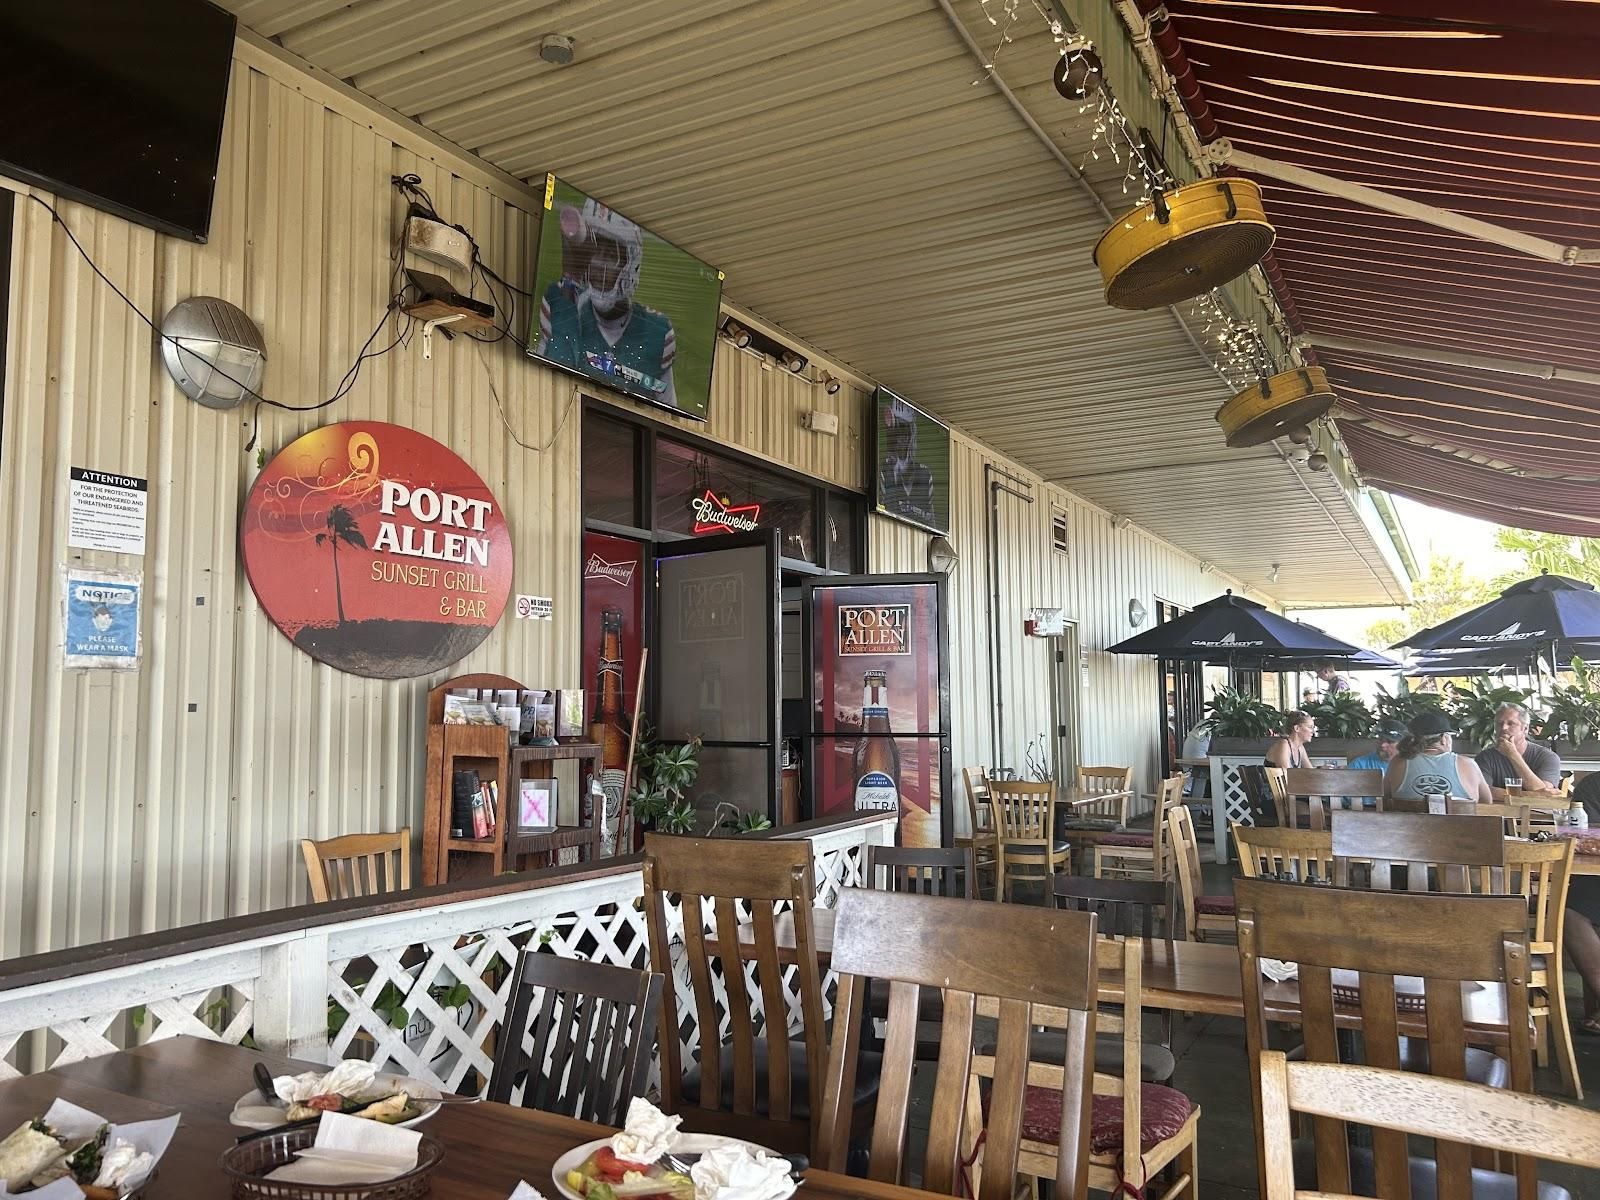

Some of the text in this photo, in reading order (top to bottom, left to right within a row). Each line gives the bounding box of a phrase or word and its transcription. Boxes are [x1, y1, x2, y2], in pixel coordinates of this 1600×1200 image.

[82, 471, 138, 488] ATTENTION
[96, 494, 131, 504] ENDANGERED
[104, 488, 138, 498] PROTECTION
[78, 499, 112, 508] THREATENED
[379, 480, 492, 532] PORT
[692, 498, 758, 532] Budweiser
[372, 521, 490, 567] ALLEN
[371, 560, 488, 594] SUNSET GRILL
[588, 559, 632, 578] Budweiser
[440, 596, 486, 618] & BAR
[844, 609, 905, 628] PORT
[845, 629, 904, 645] ALLEN
[1496, 630, 1546, 641] ANDY'S
[76, 643, 98, 651] WEAR
[857, 800, 897, 811] ULTRA
